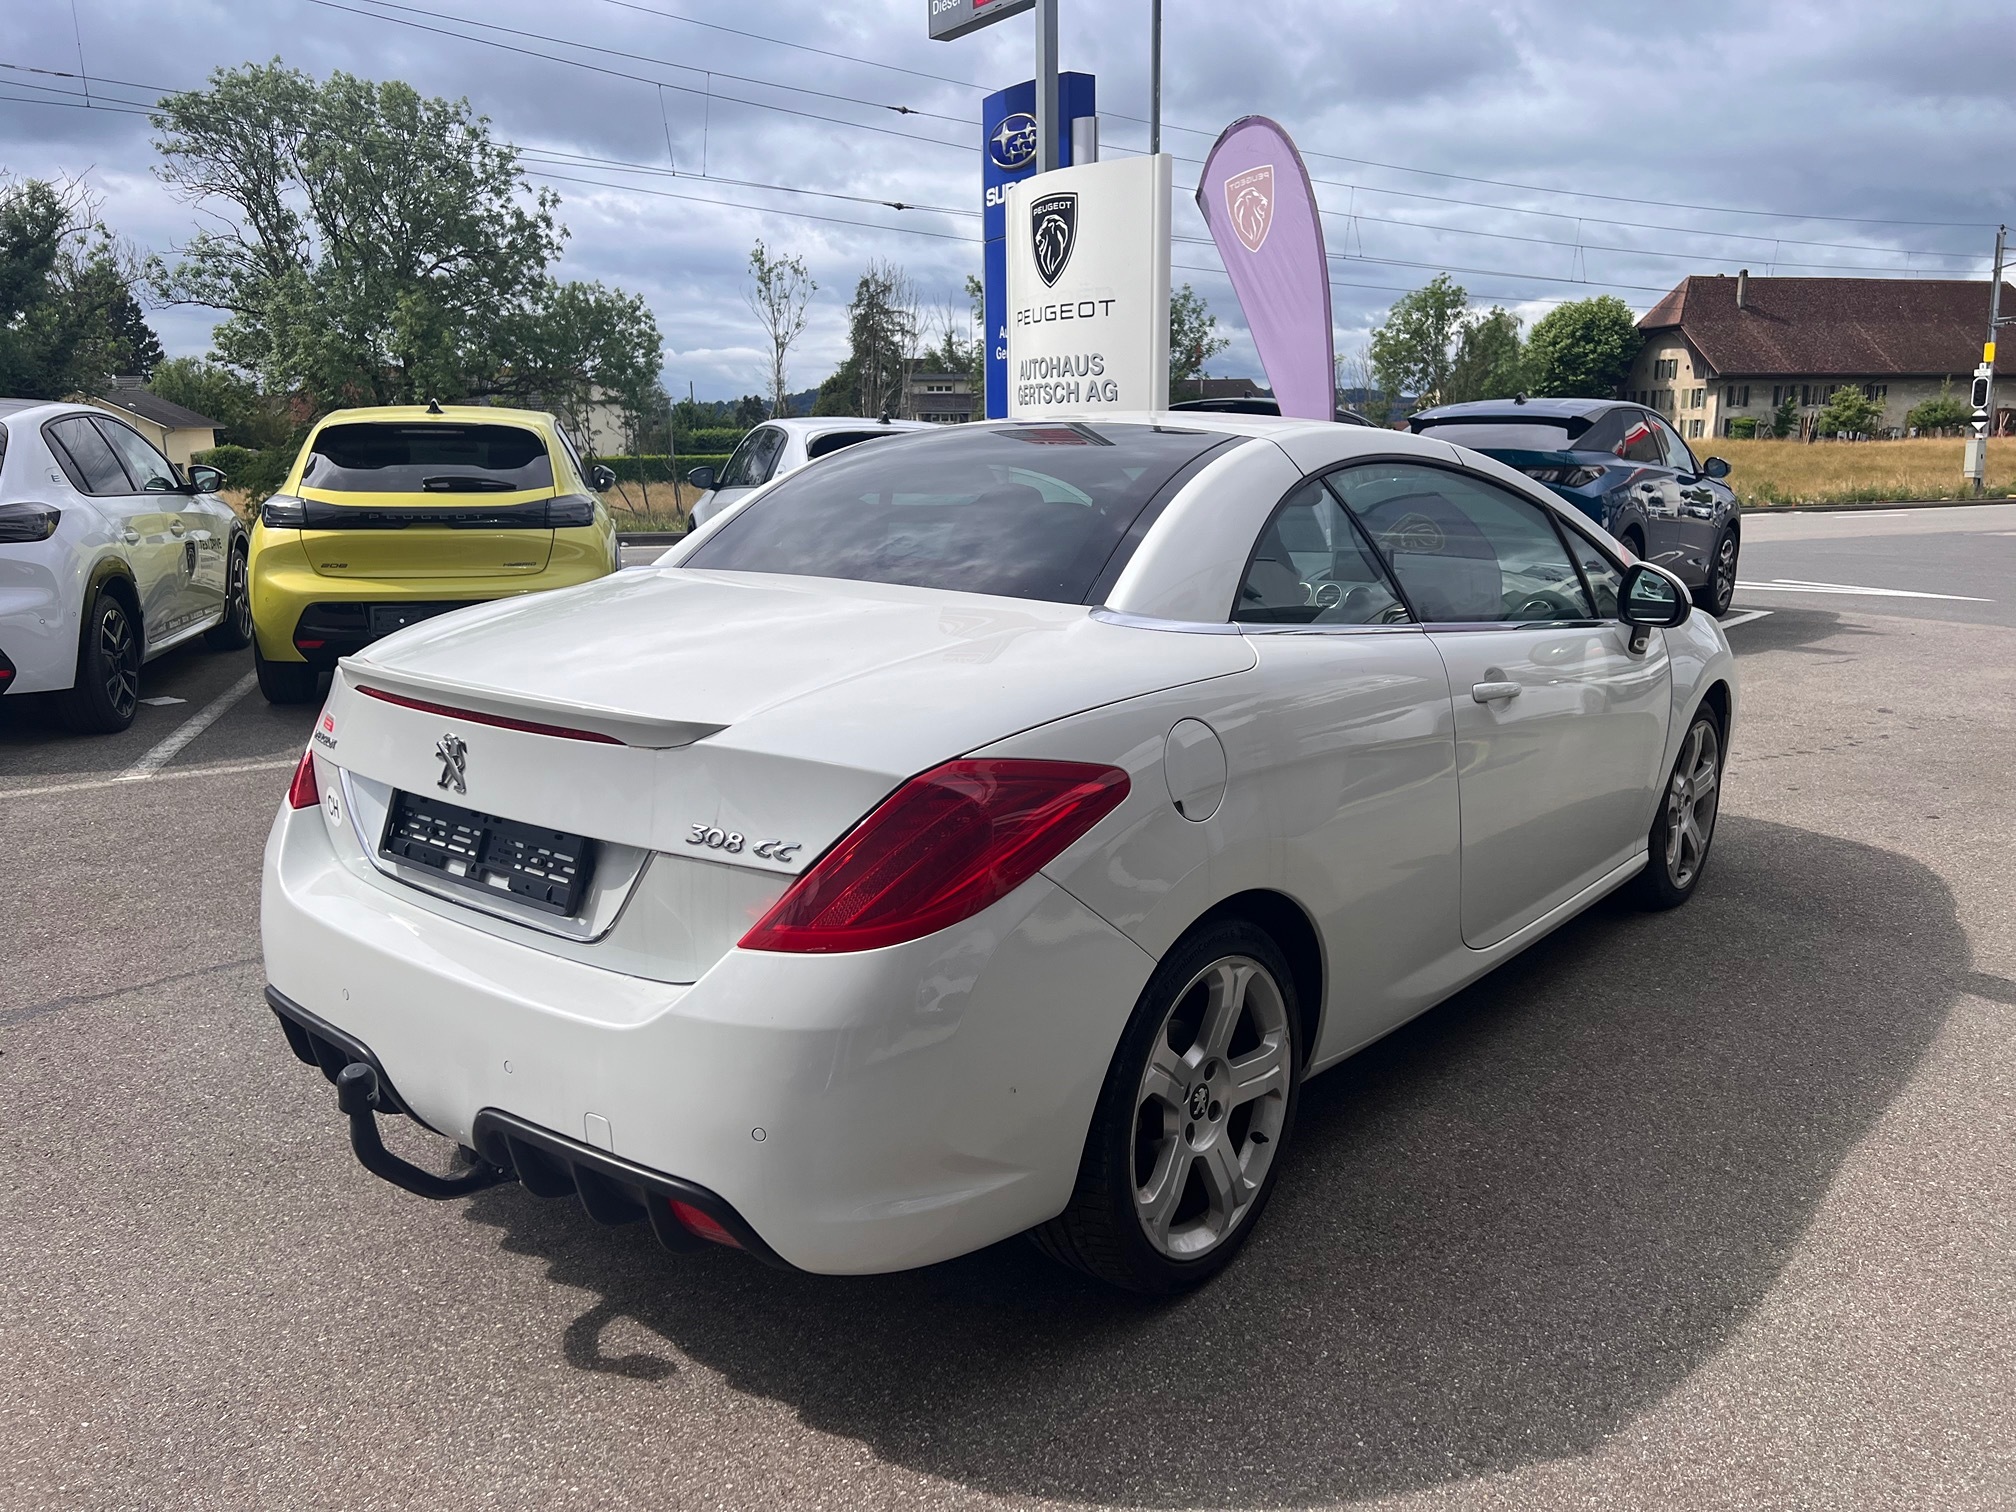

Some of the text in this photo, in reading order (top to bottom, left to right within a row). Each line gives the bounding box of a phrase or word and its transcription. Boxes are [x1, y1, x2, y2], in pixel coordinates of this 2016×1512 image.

[1033, 201, 1072, 216] PEUGEOT
[1017, 299, 1116, 327] PEUGEOT
[1020, 353, 1105, 381] AUTOHAUS
[1018, 379, 1119, 406] GERTSCH AG
[328, 795, 340, 819] CH
[685, 823, 802, 862] 308 CC
